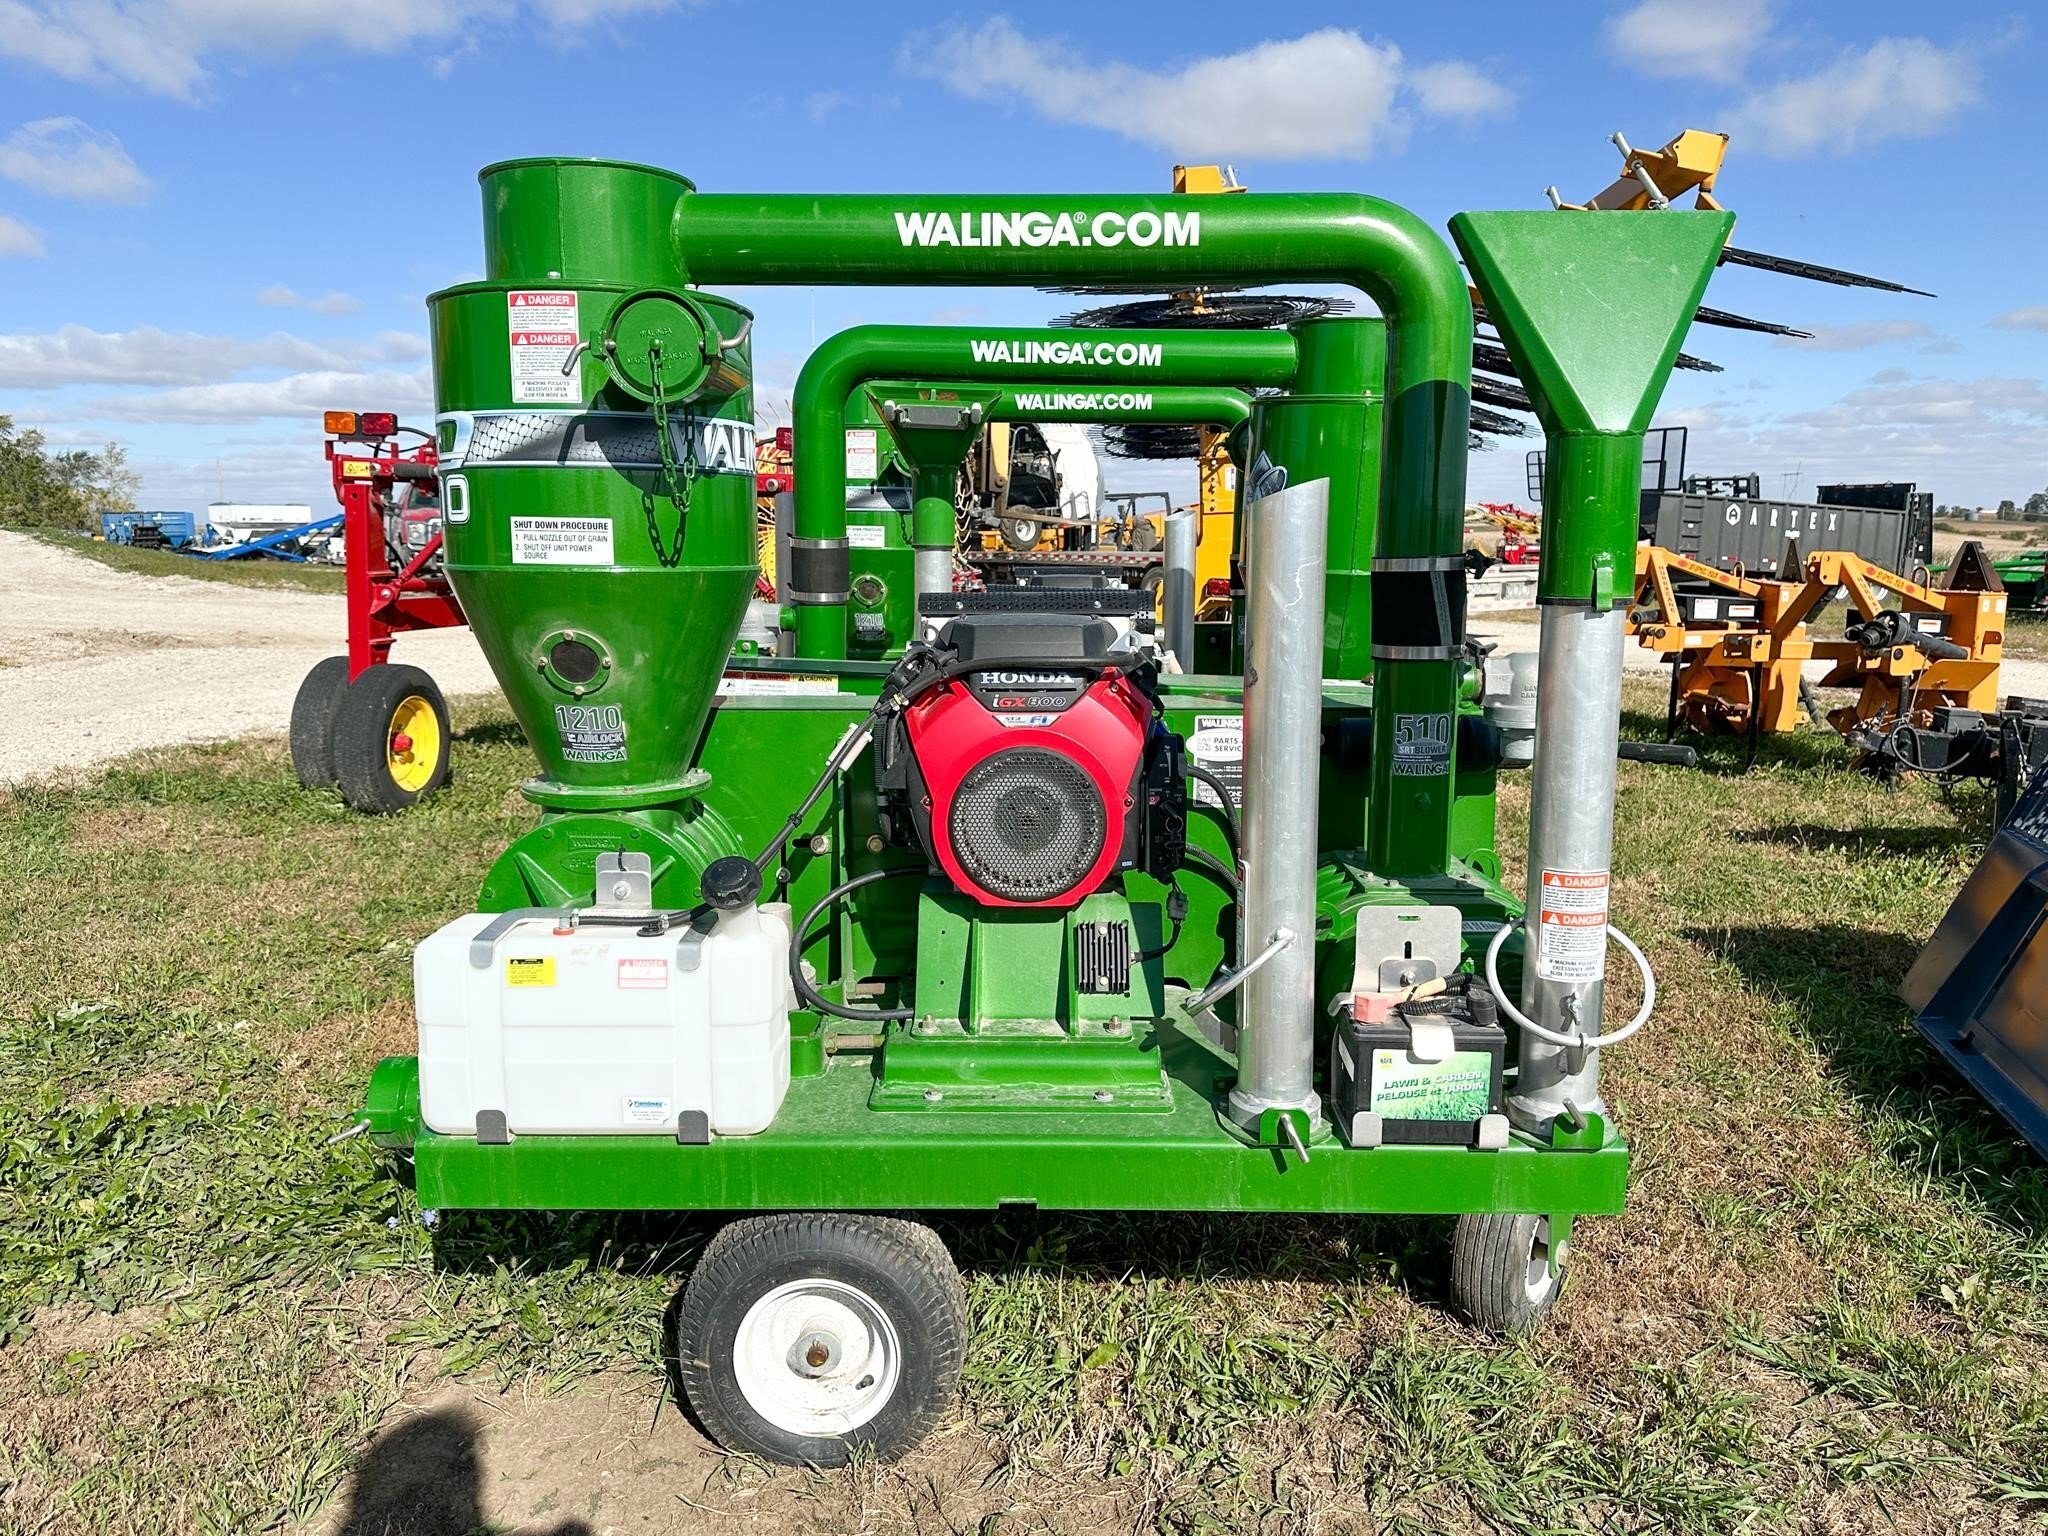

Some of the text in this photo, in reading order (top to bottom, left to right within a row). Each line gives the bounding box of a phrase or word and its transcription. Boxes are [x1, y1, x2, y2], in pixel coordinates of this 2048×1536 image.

[528, 295, 570, 305] DANGER
[530, 335, 572, 344] DANGER
[667, 420, 756, 472] WALI
[513, 520, 609, 531] SHUT DOWN PROCEDURE
[523, 533, 539, 541] PULL
[540, 534, 562, 542] NOZZLE
[563, 534, 577, 542] OUT
[578, 534, 586, 542] OF
[587, 534, 608, 543] GRAIN
[523, 543, 539, 551] SHUT
[540, 544, 552, 552] OFF
[553, 544, 568, 552] UNIT
[569, 544, 593, 552] POWER
[855, 613, 884, 626] 1210
[980, 672, 1075, 684] HONDA
[555, 706, 622, 731] 1210
[1395, 715, 1450, 745] 510
[577, 733, 623, 743] AIRLOCK
[1213, 737, 1239, 745] PARTS
[1214, 745, 1242, 753] SERVIC
[564, 749, 625, 761] WALINGA
[1394, 763, 1448, 775] WALINGA
[1564, 876, 1605, 887] DANGER
[1562, 914, 1603, 925] DANGER
[632, 960, 664, 968] DANGER
[1384, 1071, 1482, 1090] LAWN & GARDEN
[1376, 1081, 1485, 1102] PELOUSE et JARDIN
